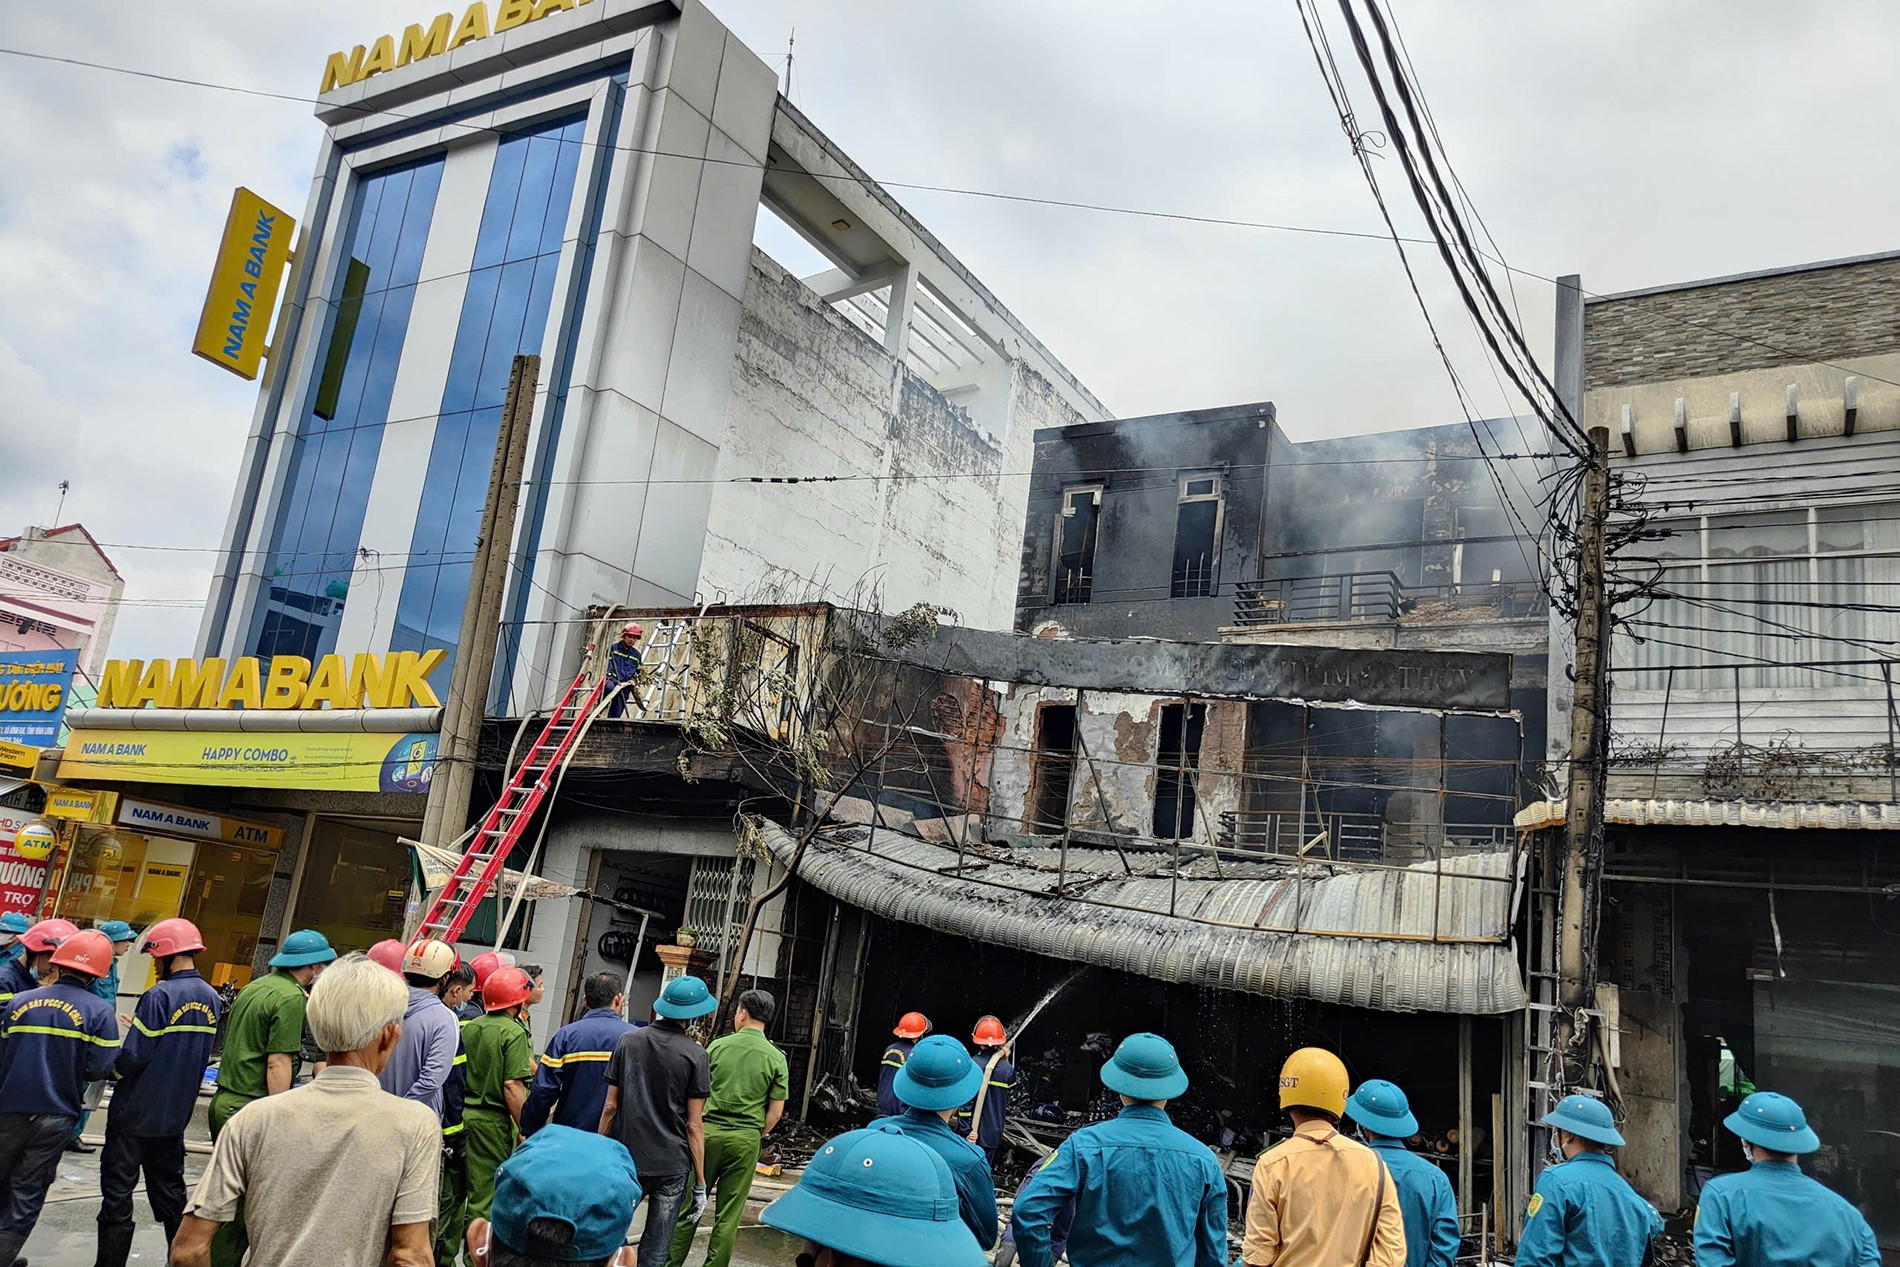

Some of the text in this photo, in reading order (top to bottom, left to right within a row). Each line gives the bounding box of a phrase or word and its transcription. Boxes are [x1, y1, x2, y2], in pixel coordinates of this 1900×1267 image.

[222, 208, 276, 360] NAM A BANK
[81, 743, 147, 756] NAM A BANK
[202, 747, 242, 761] HAPPY
[243, 748, 288, 762] COMBO
[131, 808, 211, 831] NAM A BANK
[234, 825, 269, 844] ATM
[23, 839, 52, 849] ATM
[4, 891, 35, 908] TRỢ
